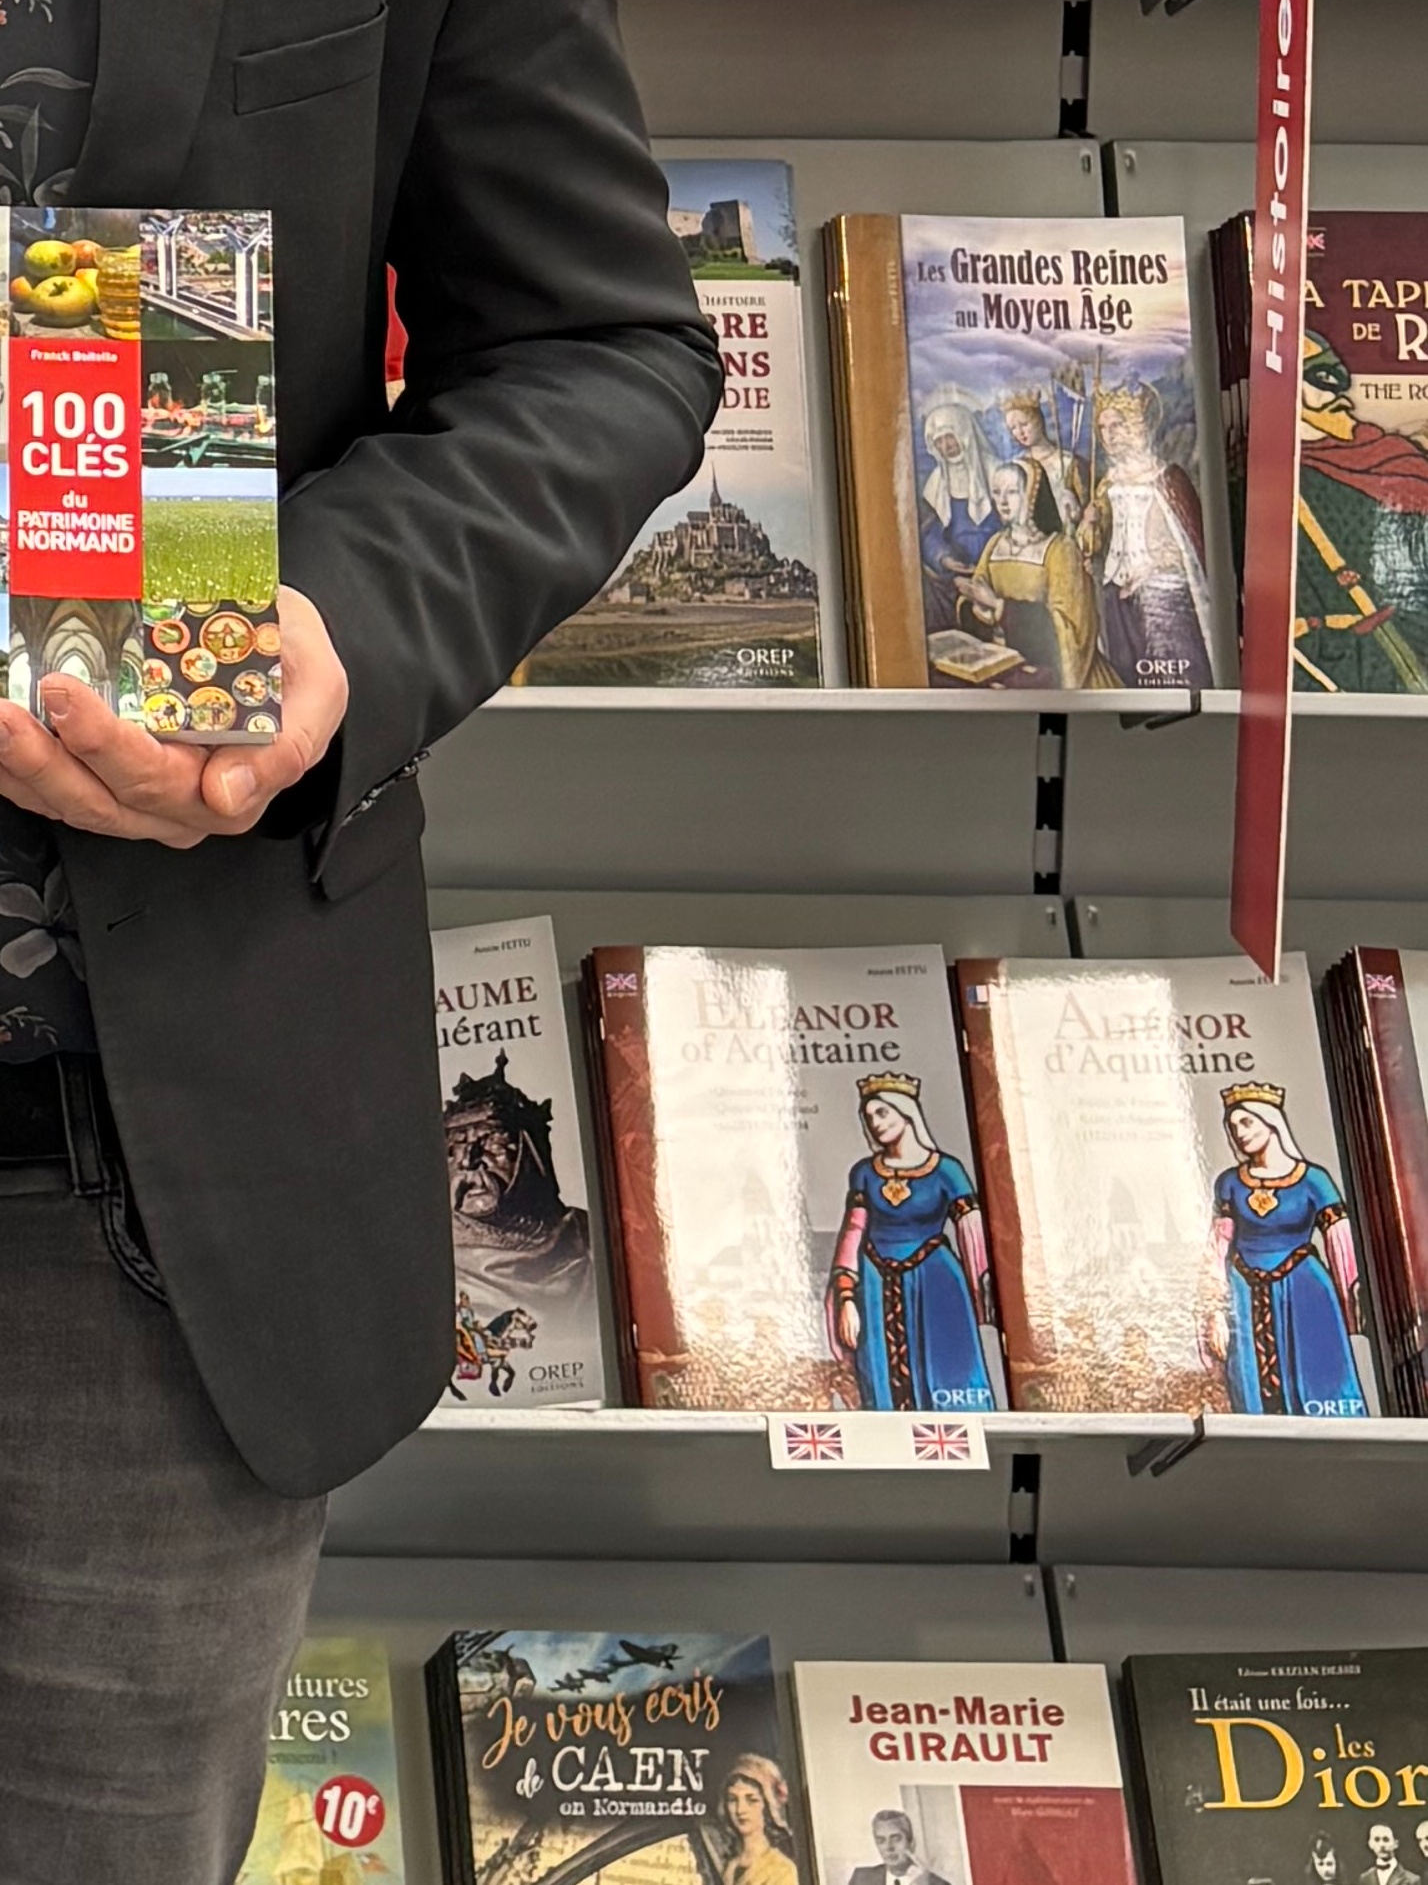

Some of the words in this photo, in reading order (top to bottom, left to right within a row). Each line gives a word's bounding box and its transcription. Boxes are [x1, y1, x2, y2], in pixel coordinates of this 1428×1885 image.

[918, 261, 945, 283] Les
[951, 247, 1063, 285] Grandes
[1071, 249, 1168, 286] Reines
[955, 309, 978, 328] au
[982, 292, 1071, 334] Moyen
[1080, 287, 1133, 335] Âge
[1352, 322, 1382, 341] DE
[30, 348, 71, 362] Franck
[1360, 383, 1402, 400] THE
[22, 390, 126, 440] 100
[22, 432, 130, 479] CLÉS
[62, 489, 88, 509] du
[17, 509, 135, 532] PATRIMOINE
[17, 528, 135, 554] NORMAND
[737, 648, 794, 666] OREP
[1135, 659, 1191, 676] OREP
[529, 1361, 584, 1381] OREP
[932, 1387, 991, 1407] OREP
[1303, 1398, 1364, 1417] OREP
[849, 1695, 1064, 1728] Jean-Marie
[1188, 1687, 1210, 1712] Il
[1214, 1692, 1251, 1711] était
[1258, 1698, 1291, 1711] une
[482, 1697, 536, 1769] Je
[547, 1691, 635, 1747] vous
[646, 1676, 724, 1732] écris
[869, 1731, 1053, 1764] GIRAULT
[1335, 1722, 1376, 1758] les
[516, 1757, 544, 1798] de
[552, 1746, 710, 1791] CAEN
[1194, 1717, 1428, 1809] Dior
[559, 1801, 585, 1816] en
[594, 1797, 707, 1816] Normandie
